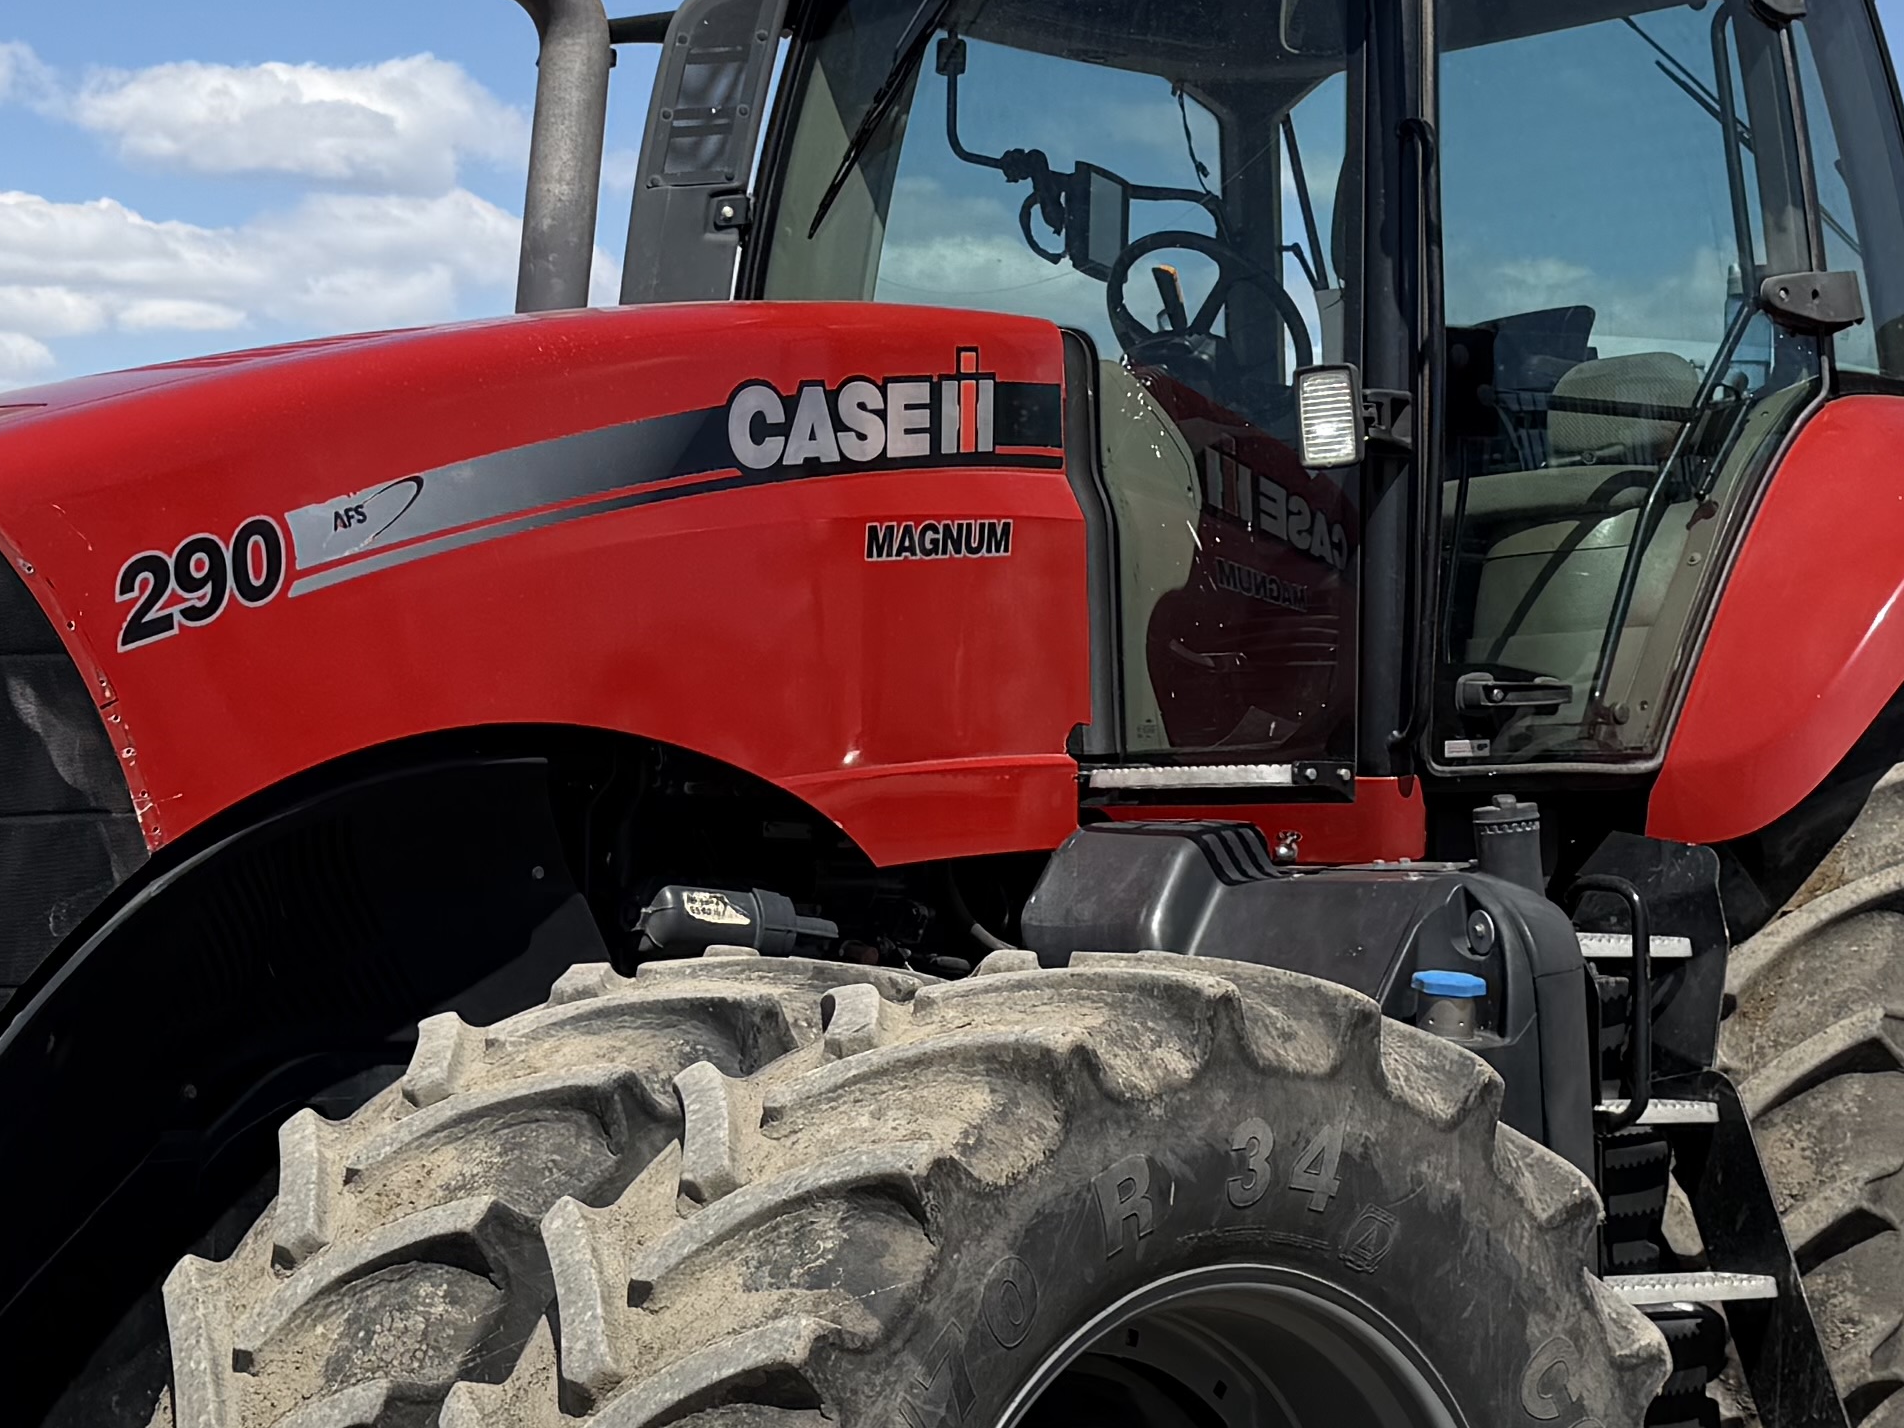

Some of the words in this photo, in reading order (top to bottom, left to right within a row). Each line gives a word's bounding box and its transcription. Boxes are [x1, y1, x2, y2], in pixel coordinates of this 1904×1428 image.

[728, 380, 930, 469] CASE
[333, 504, 367, 533] AFS
[864, 520, 1013, 561] MAGNUM
[115, 514, 286, 653] 290
[1092, 1153, 1154, 1260] R
[1225, 1117, 1353, 1212] 34
